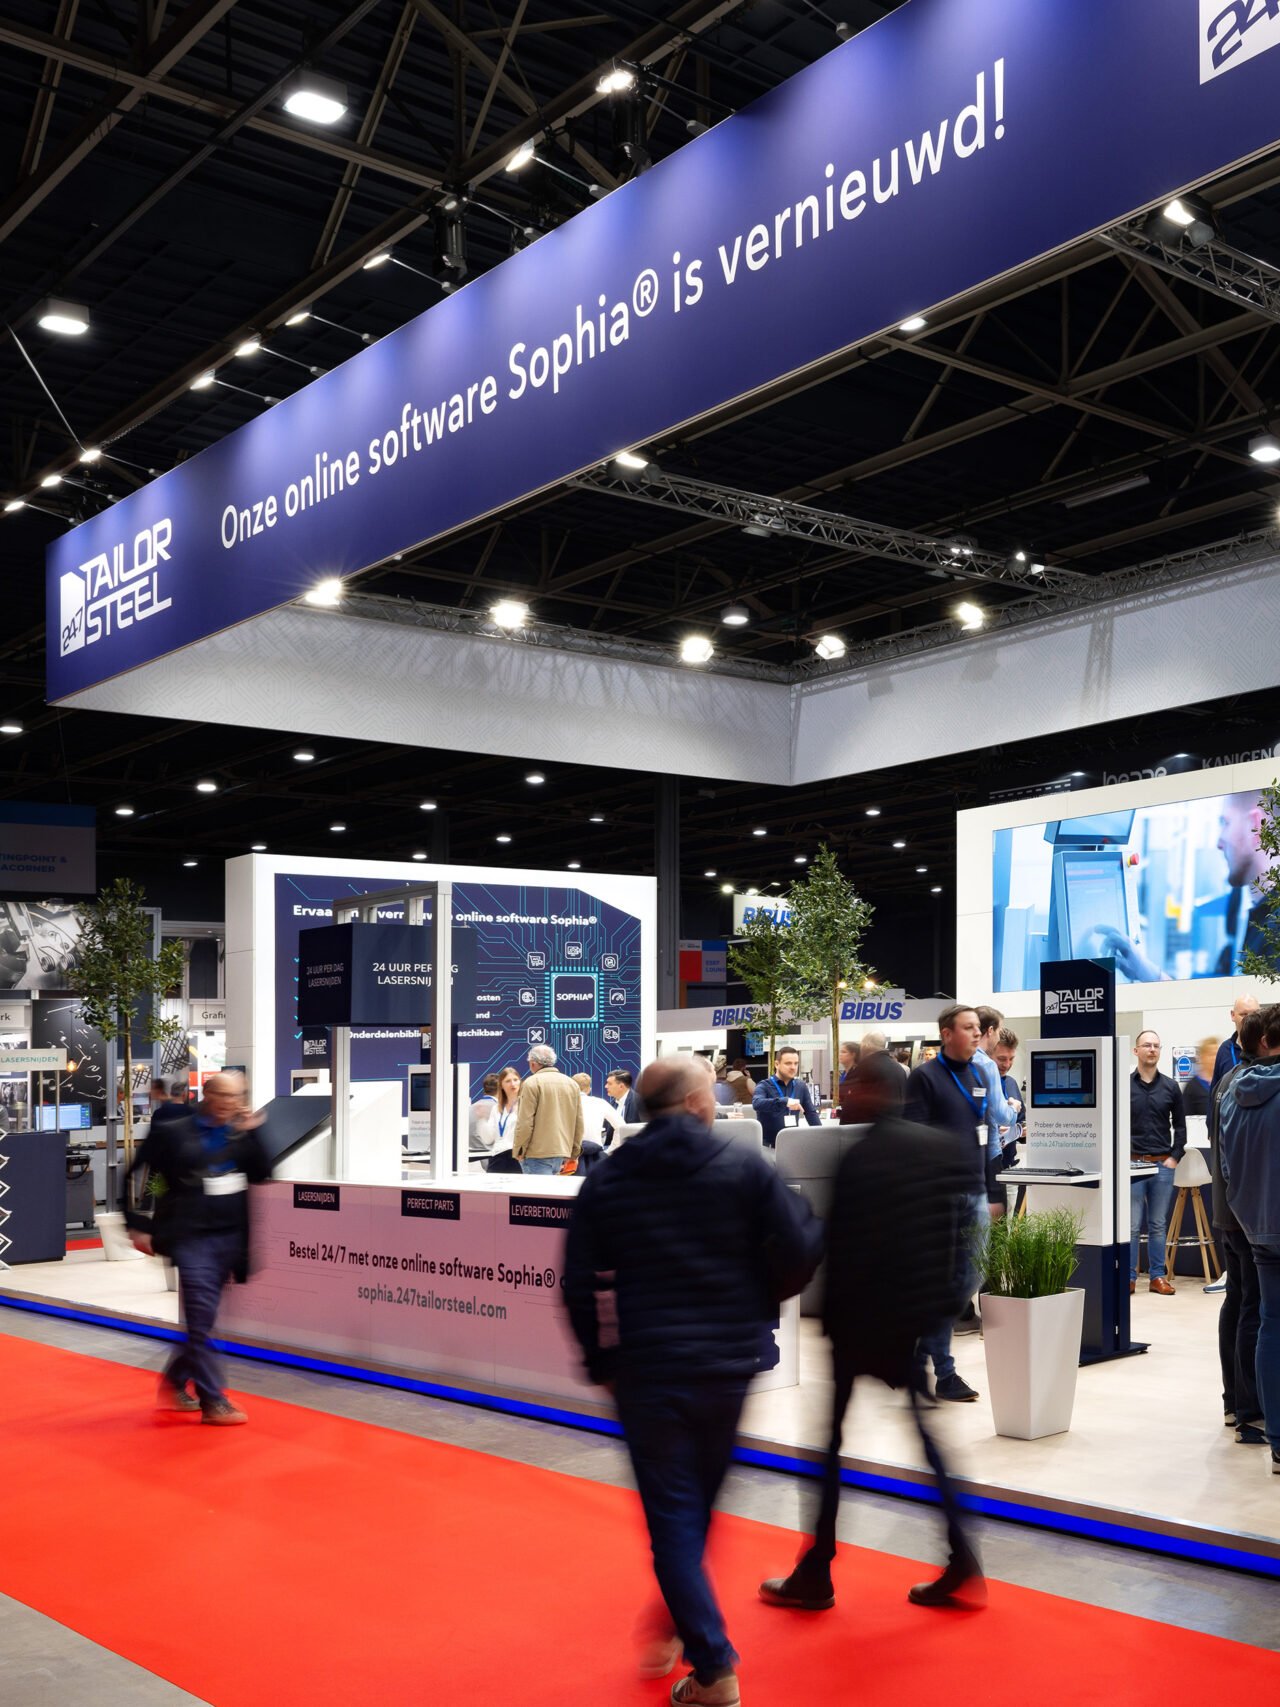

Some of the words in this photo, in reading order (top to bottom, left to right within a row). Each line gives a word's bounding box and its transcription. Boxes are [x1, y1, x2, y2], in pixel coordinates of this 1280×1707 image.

[1207, 0, 1280, 70] 24
[221, 493, 278, 549] Onze
[285, 450, 361, 519] online
[368, 373, 499, 477] software
[508, 268, 660, 400] Sophia®
[672, 251, 704, 313] is
[718, 58, 1006, 286] vernieuwd!
[79, 518, 172, 600] TAILOR
[87, 571, 172, 645] STEEL
[62, 606, 83, 651] 247
[293, 905, 333, 917] Ervaa
[456, 911, 493, 922] online
[496, 913, 548, 924] software
[372, 963, 386, 972] 24
[389, 963, 411, 972] UUR
[377, 976, 453, 987] LASERSNIJ
[477, 994, 500, 1002] osten
[1057, 988, 1104, 1001] TAILOR
[841, 1002, 903, 1020] BIBUS
[1046, 1002, 1058, 1013] 247
[1059, 1000, 1104, 1013] STEEL
[202, 1011, 226, 1020] Grafi
[712, 1007, 755, 1026] BIBUS
[457, 1029, 504, 1037] eschikbaar
[298, 1191, 335, 1205] LASERSNIJDEN
[407, 1198, 433, 1210] PERFECT
[434, 1199, 454, 1212] PARTS
[511, 1204, 573, 1220] LEVERBETROUW
[289, 1241, 319, 1260] Bestel
[321, 1244, 346, 1263] 24/7
[349, 1251, 369, 1267] met
[372, 1254, 398, 1270] onze
[401, 1252, 436, 1275] online
[439, 1257, 494, 1281] software
[497, 1263, 555, 1290] Sophia®
[358, 1283, 507, 1320] sophia.247tailorsteel.com
